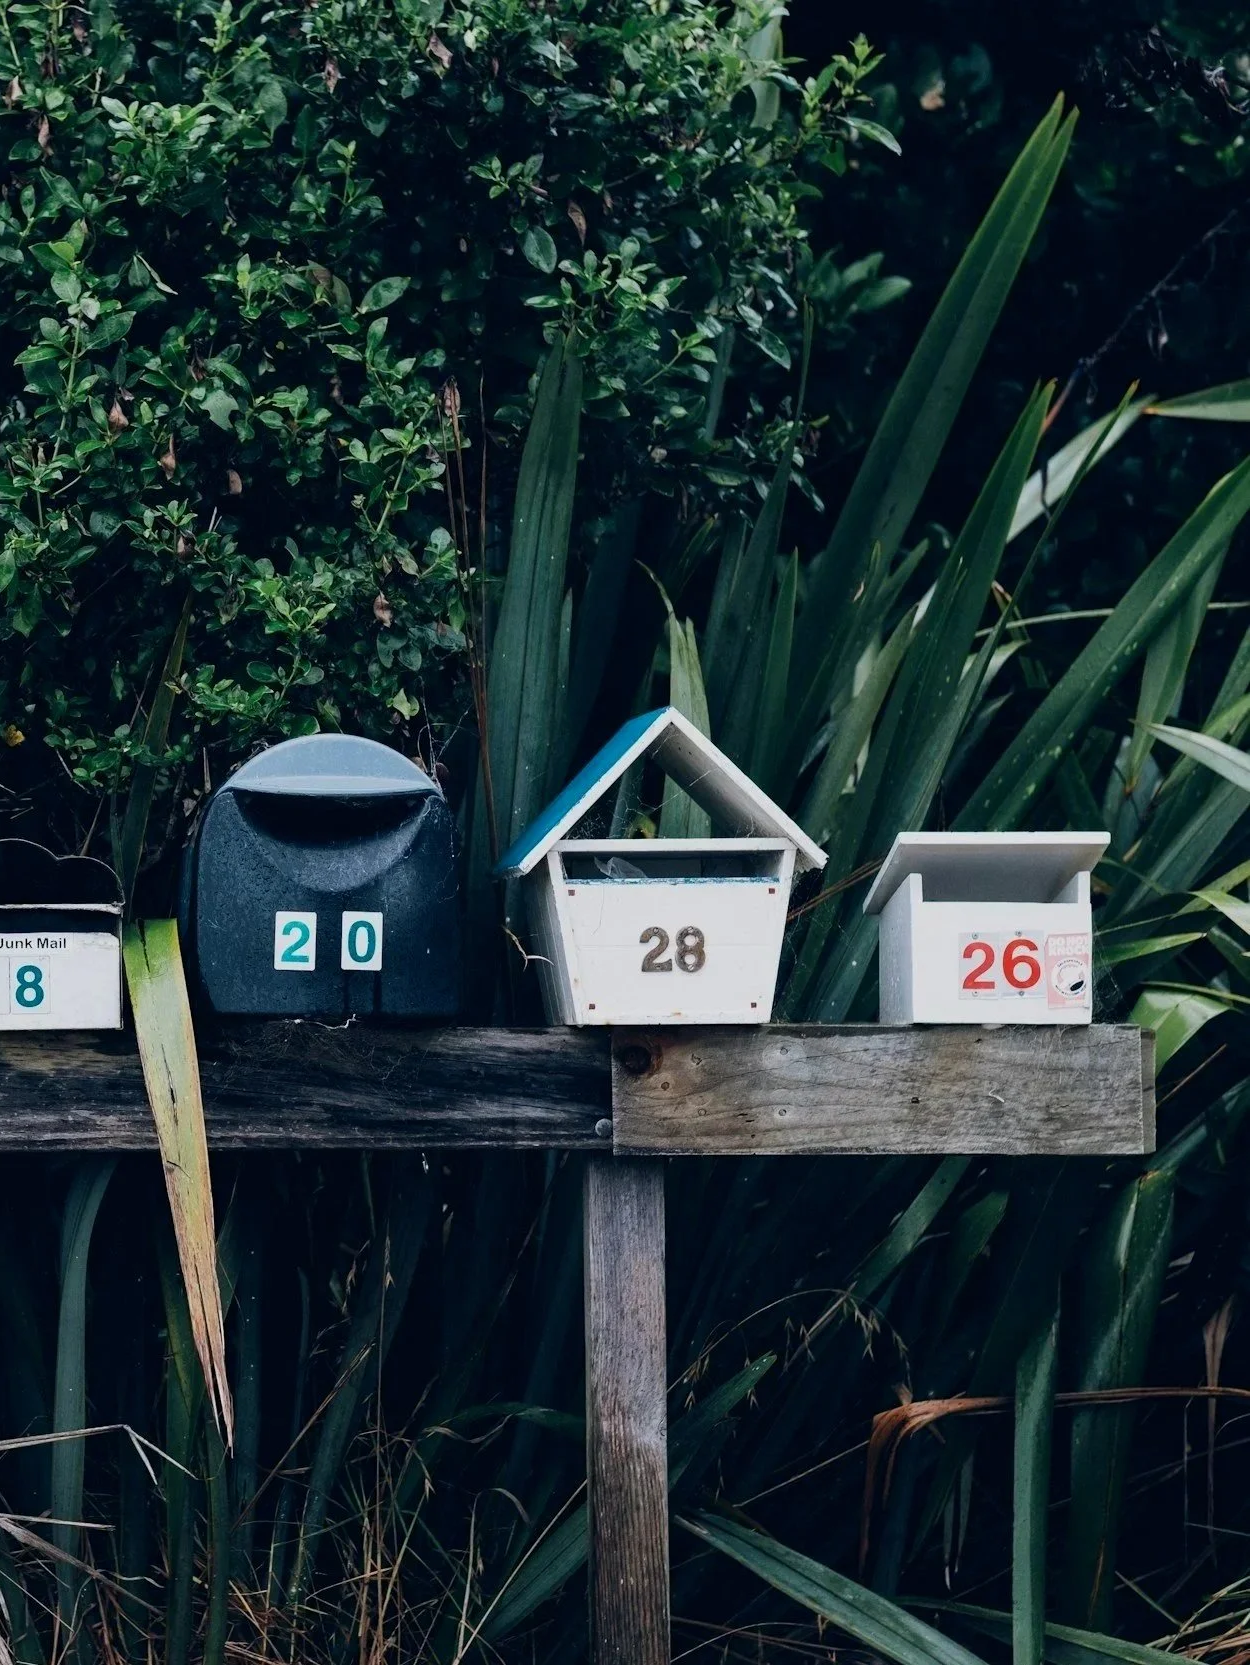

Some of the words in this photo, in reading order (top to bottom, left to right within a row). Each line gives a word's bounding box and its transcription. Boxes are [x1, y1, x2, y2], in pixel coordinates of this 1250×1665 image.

[37, 937, 67, 949] Mail
[639, 925, 707, 973] 28
[962, 938, 1041, 990] 26
